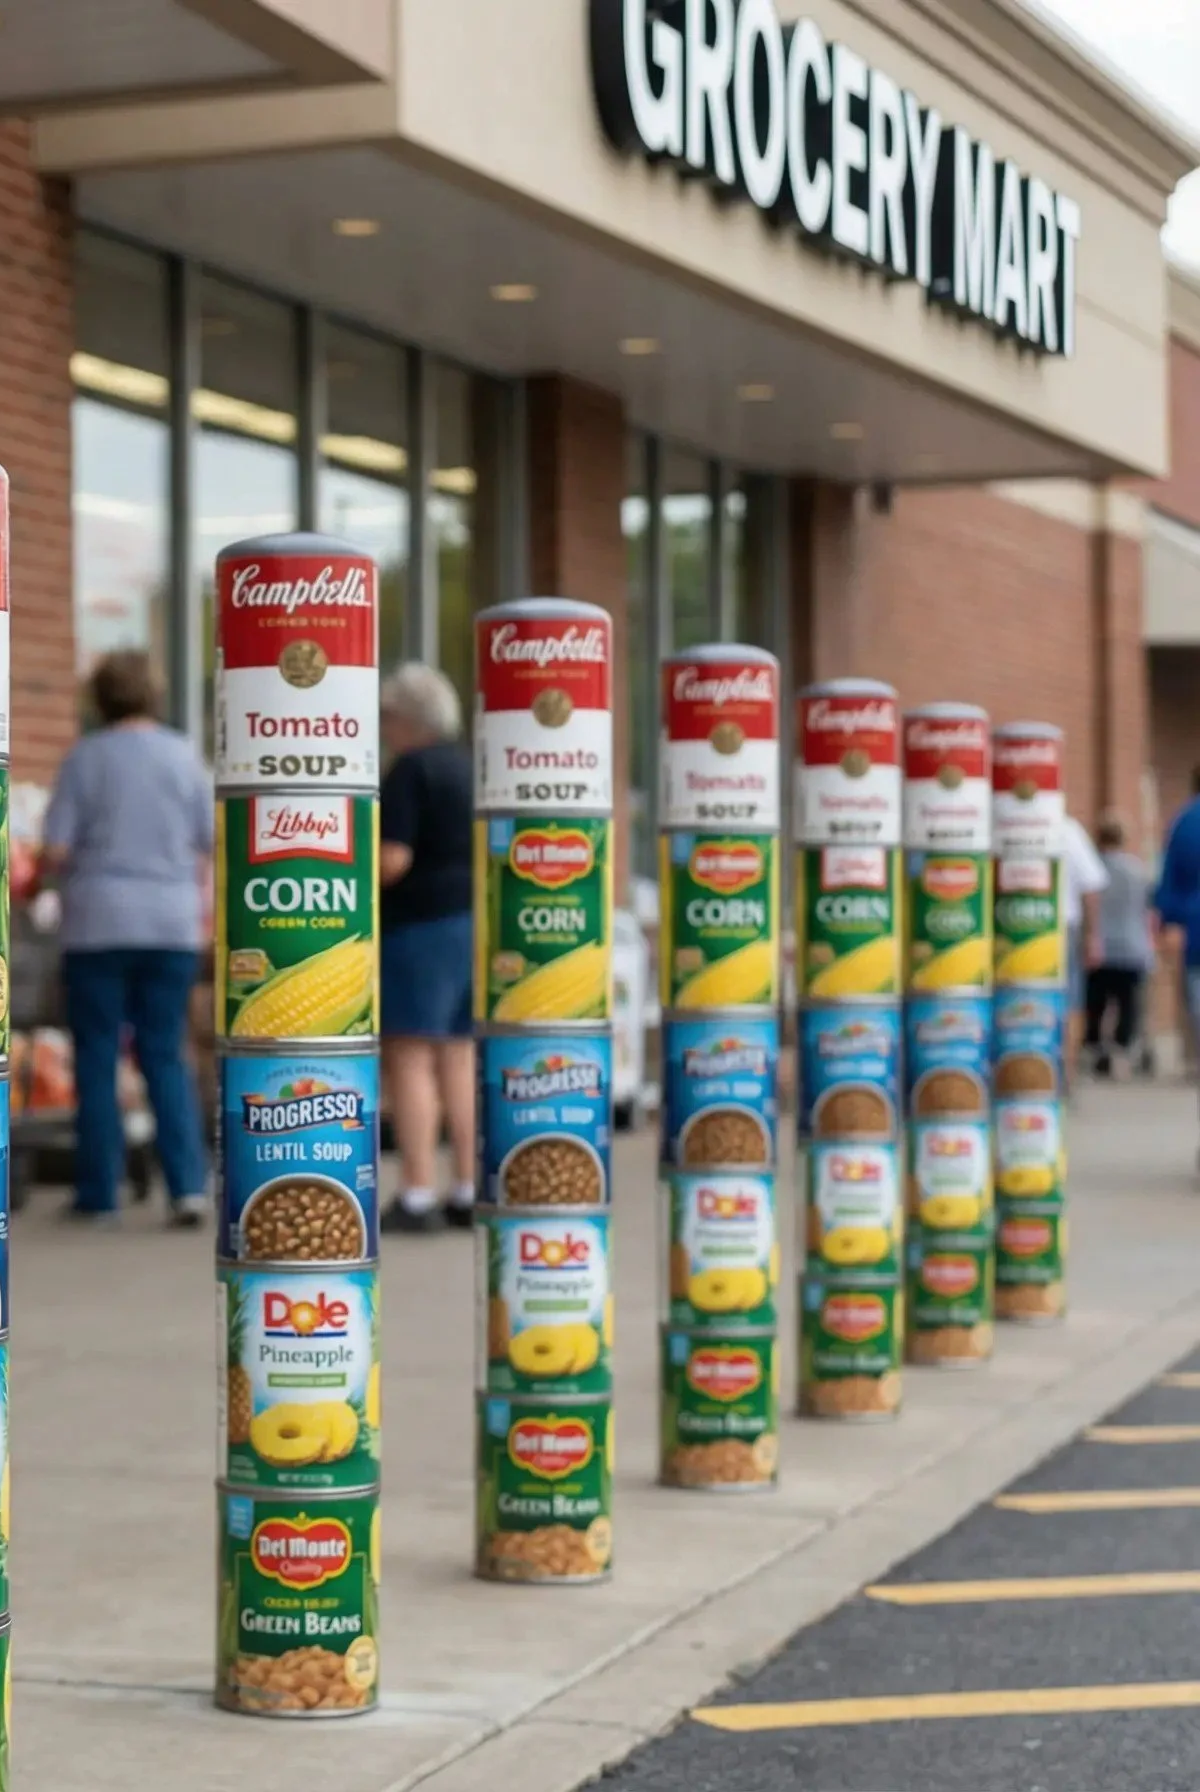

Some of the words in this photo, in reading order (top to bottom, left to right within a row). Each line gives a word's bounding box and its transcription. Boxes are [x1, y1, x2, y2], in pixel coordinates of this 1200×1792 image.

[622, 0, 942, 288] GROCERY
[953, 124, 1081, 359] MART
[231, 563, 372, 614] Campbell's
[245, 711, 359, 738] Tomato
[258, 754, 347, 777] SOUP
[504, 747, 598, 769] Tomato
[260, 804, 339, 840] Libby's
[243, 877, 358, 912] CORN
[518, 906, 587, 931] CORN
[685, 898, 766, 928] CORN
[249, 1093, 358, 1131] PROGRESSO
[255, 1142, 308, 1162] LENTIL
[312, 1141, 353, 1162] SOUP
[519, 1232, 590, 1267] Dole
[263, 1291, 349, 1332] Dole
[259, 1344, 354, 1368] Pineapple
